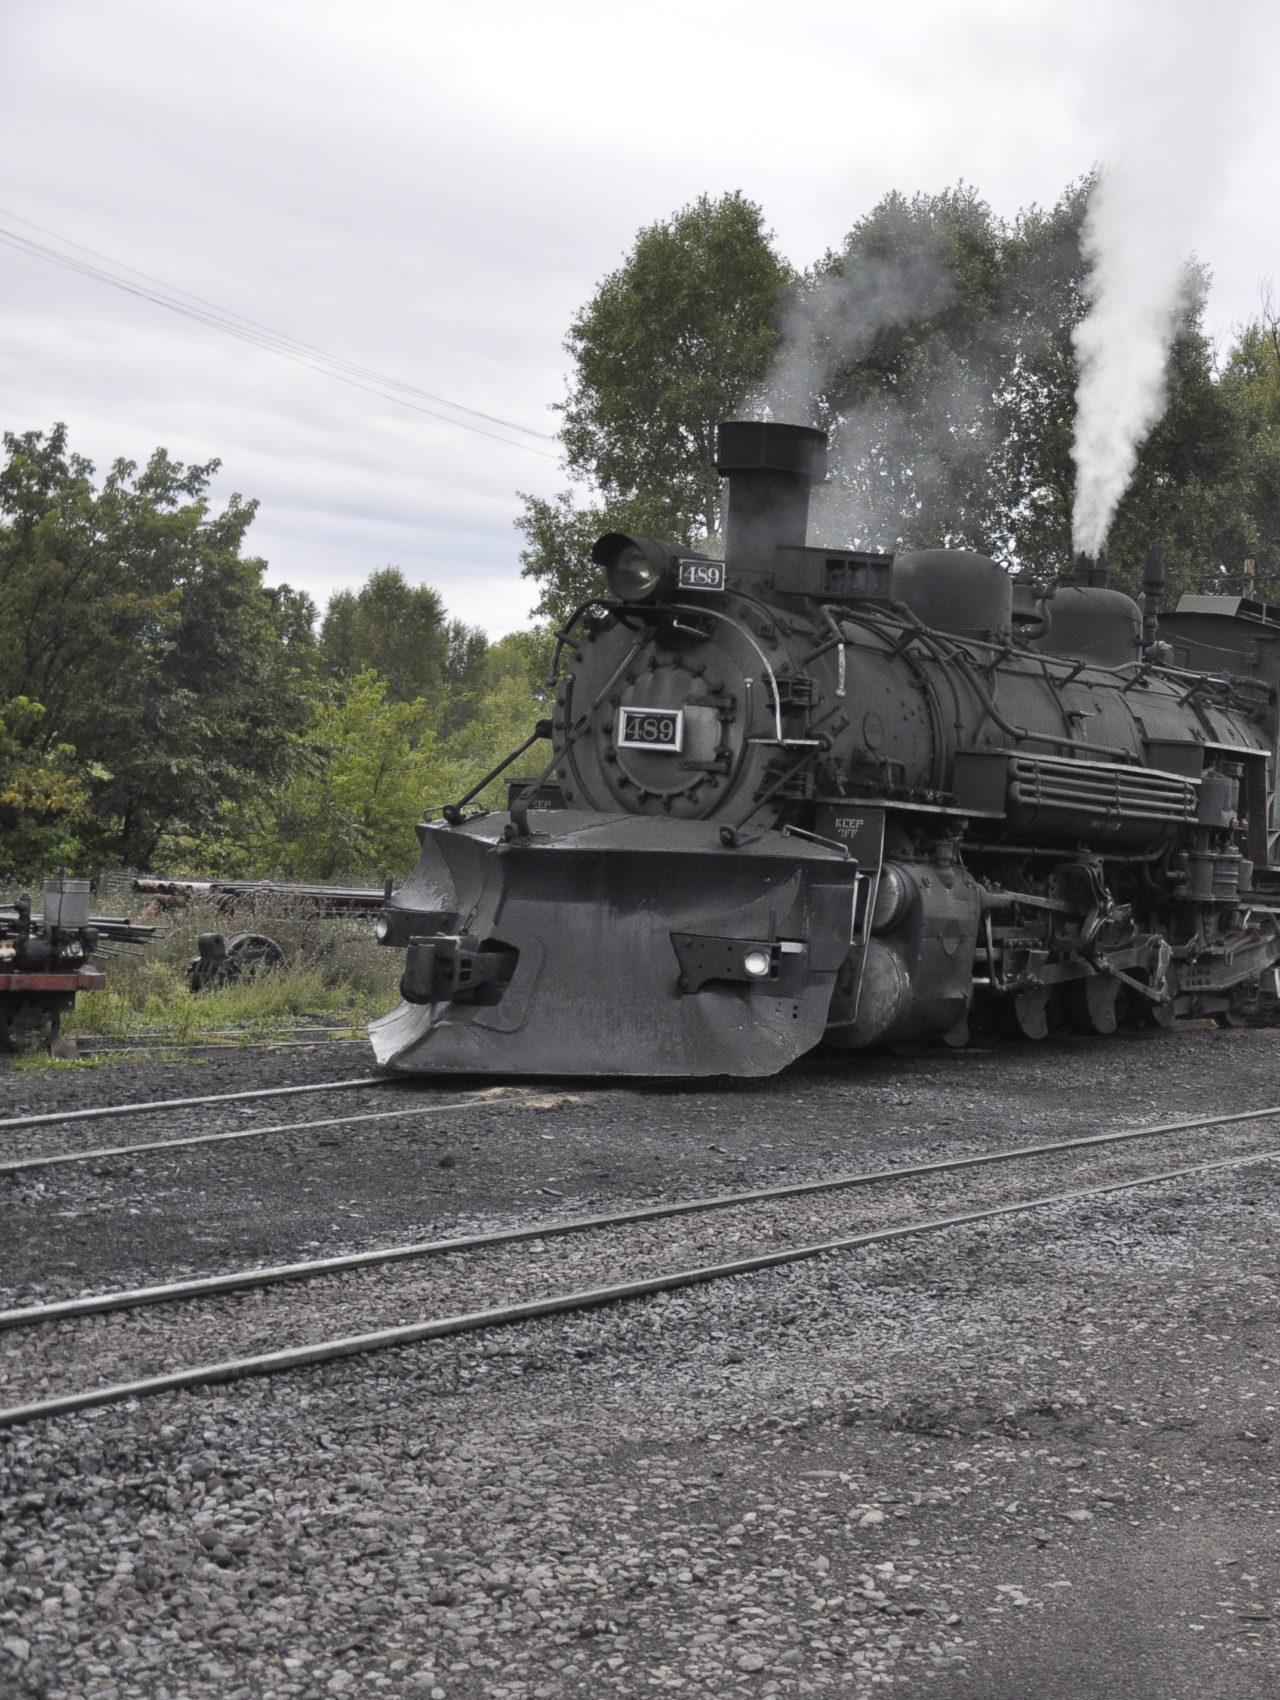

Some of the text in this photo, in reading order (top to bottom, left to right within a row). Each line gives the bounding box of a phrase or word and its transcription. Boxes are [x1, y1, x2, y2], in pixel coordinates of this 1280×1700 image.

[684, 566, 720, 585] 489
[627, 719, 673, 741] 489
[835, 817, 864, 828] KEEP
[837, 828, 858, 838] OFF
